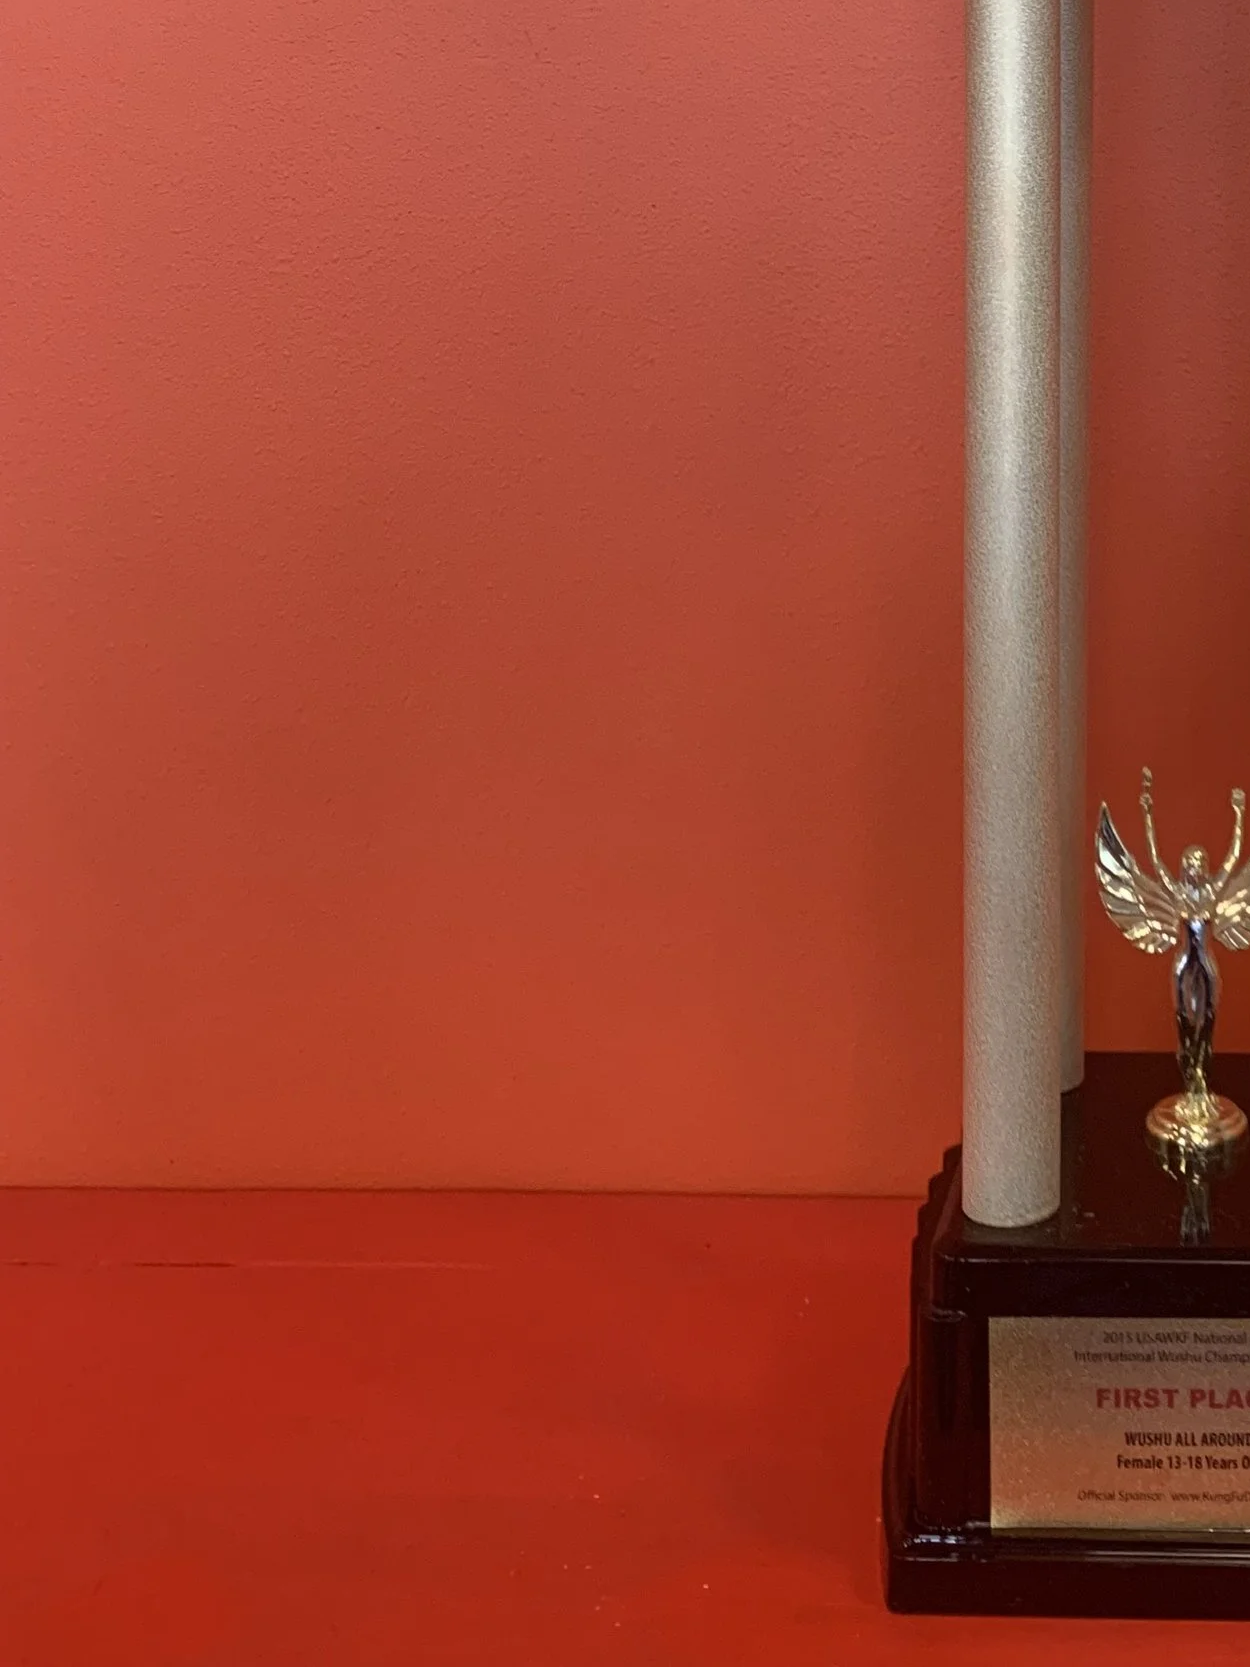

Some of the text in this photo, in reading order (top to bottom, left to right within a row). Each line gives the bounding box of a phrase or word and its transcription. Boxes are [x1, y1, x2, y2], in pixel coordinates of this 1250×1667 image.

[1194, 1332, 1247, 1345] National
[1074, 1351, 1155, 1362] International
[1158, 1351, 1201, 1363] Wushu
[1096, 1388, 1179, 1409] FIRST
[1125, 1432, 1172, 1446] WUSHU
[1175, 1432, 1197, 1446] ALL
[1117, 1455, 1163, 1469] Female
[1168, 1456, 1202, 1469] 13-18
[1205, 1456, 1238, 1470] Years
[1078, 1490, 1115, 1501] Official
